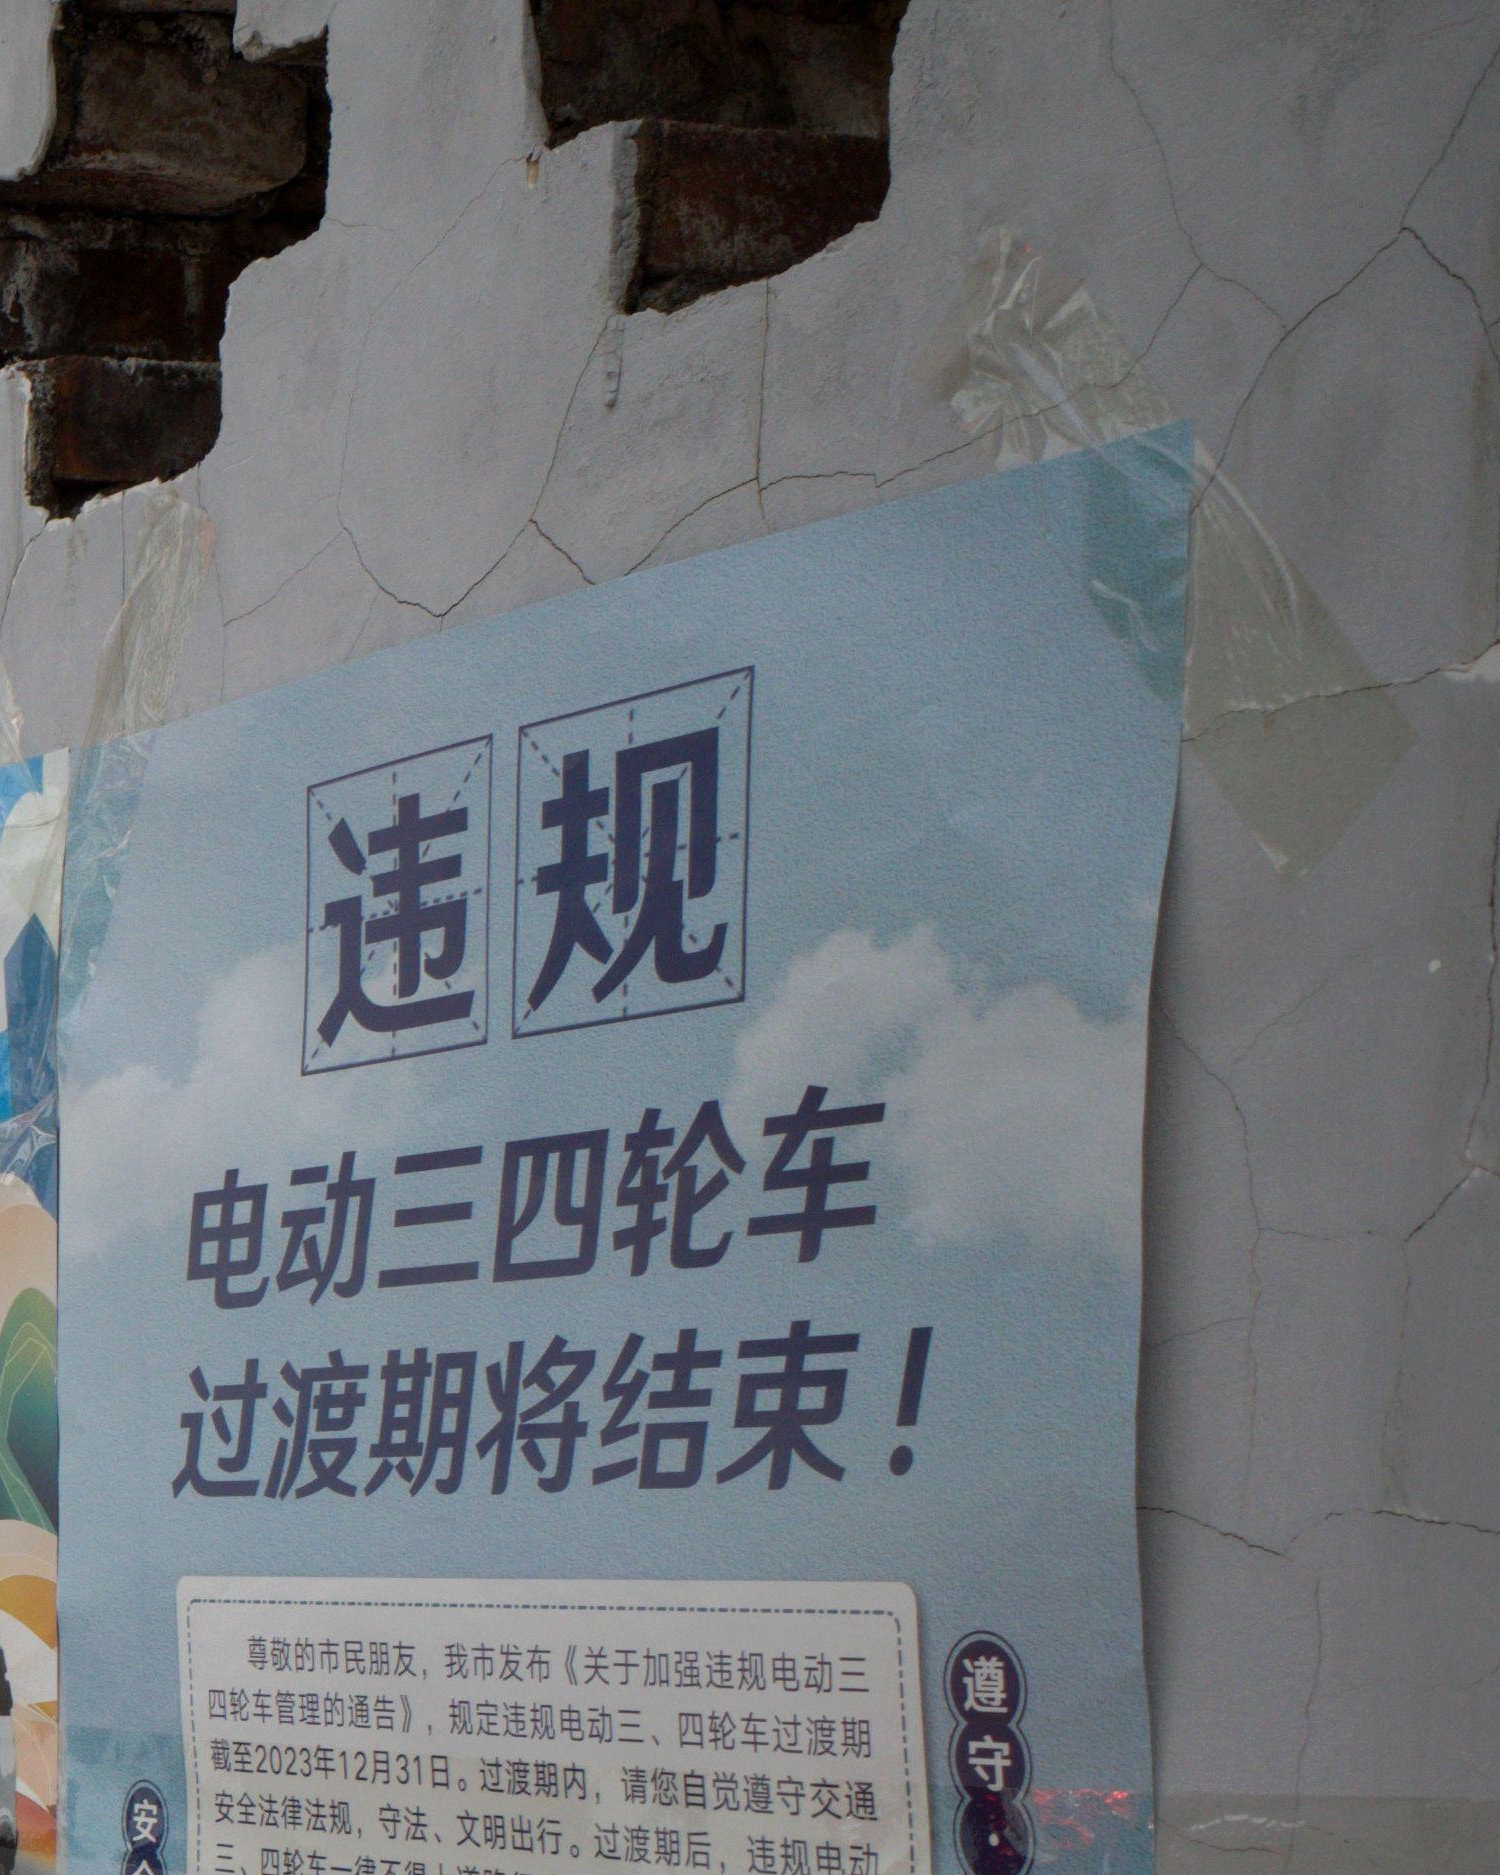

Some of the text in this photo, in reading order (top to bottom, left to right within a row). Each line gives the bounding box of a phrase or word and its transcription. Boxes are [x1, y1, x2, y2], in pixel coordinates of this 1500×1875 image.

[317, 727, 728, 1047] 违规
[185, 1084, 886, 1310] 电动三四轮车
[171, 1320, 934, 1500] 过渡期将结束！
[207, 1688, 872, 1758] 四轮车管理的通告》，规定违规电动三、四轮车过渡期
[247, 1635, 870, 1694] 尊敬的市民朋友，我市发布《关于加强违规电动三
[210, 1738, 878, 1822] 截至2023年12月31日。过渡期内，请您自觉遵守交通
